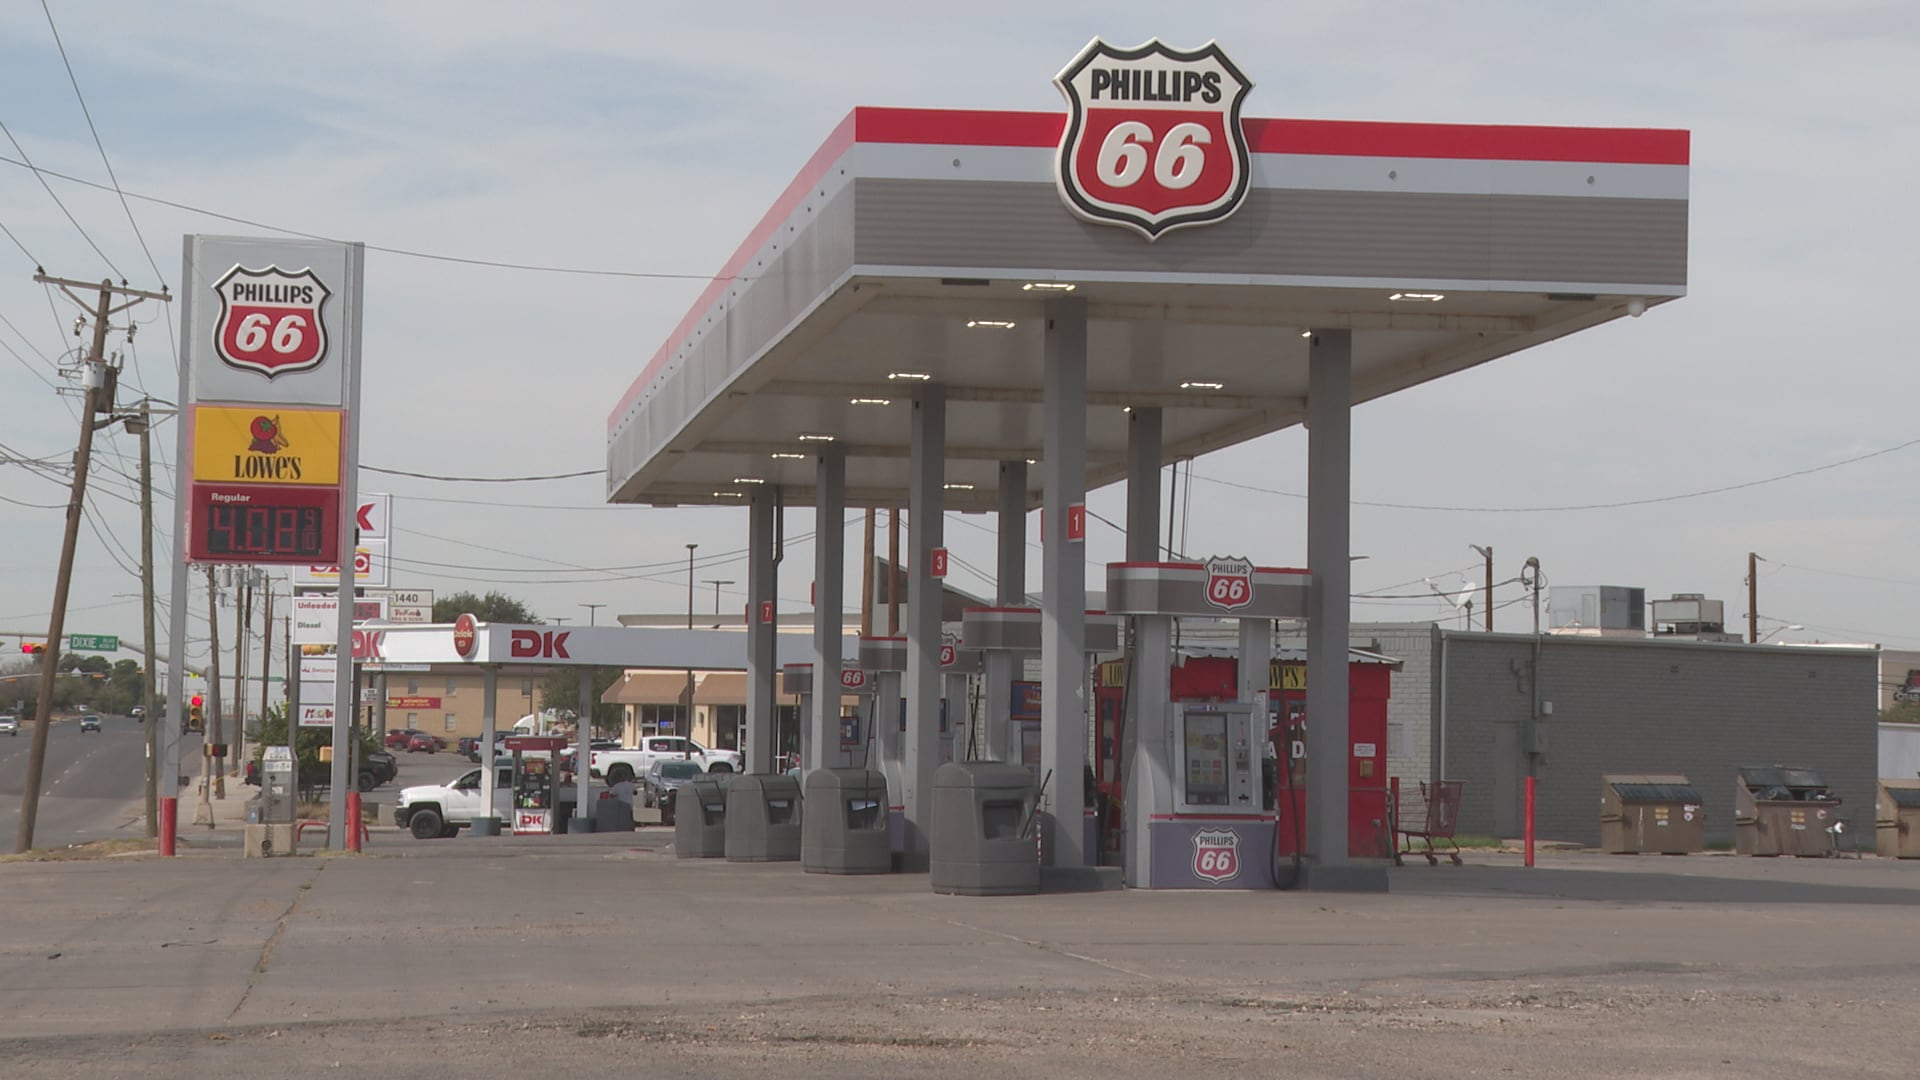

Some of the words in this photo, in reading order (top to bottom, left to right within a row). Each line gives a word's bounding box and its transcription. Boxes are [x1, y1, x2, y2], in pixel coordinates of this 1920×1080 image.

[1090, 68, 1221, 104] PHILLIPS
[1096, 120, 1212, 190] 66
[233, 282, 313, 304] PHILLIPS
[235, 313, 307, 354] 66
[211, 493, 251, 503] Regular
[1073, 513, 1079, 532] 1
[936, 555, 943, 570] 3
[1212, 564, 1248, 574] PHILLIPS
[1213, 578, 1246, 600] 66
[395, 594, 418, 603] 1440
[764, 607, 770, 618] 7
[72, 636, 97, 649] DIXIE
[511, 630, 571, 658] DK
[843, 672, 861, 684] 66
[522, 815, 542, 824] DK
[1199, 836, 1234, 846] PHILLIPS
[1201, 850, 1232, 871] 66
